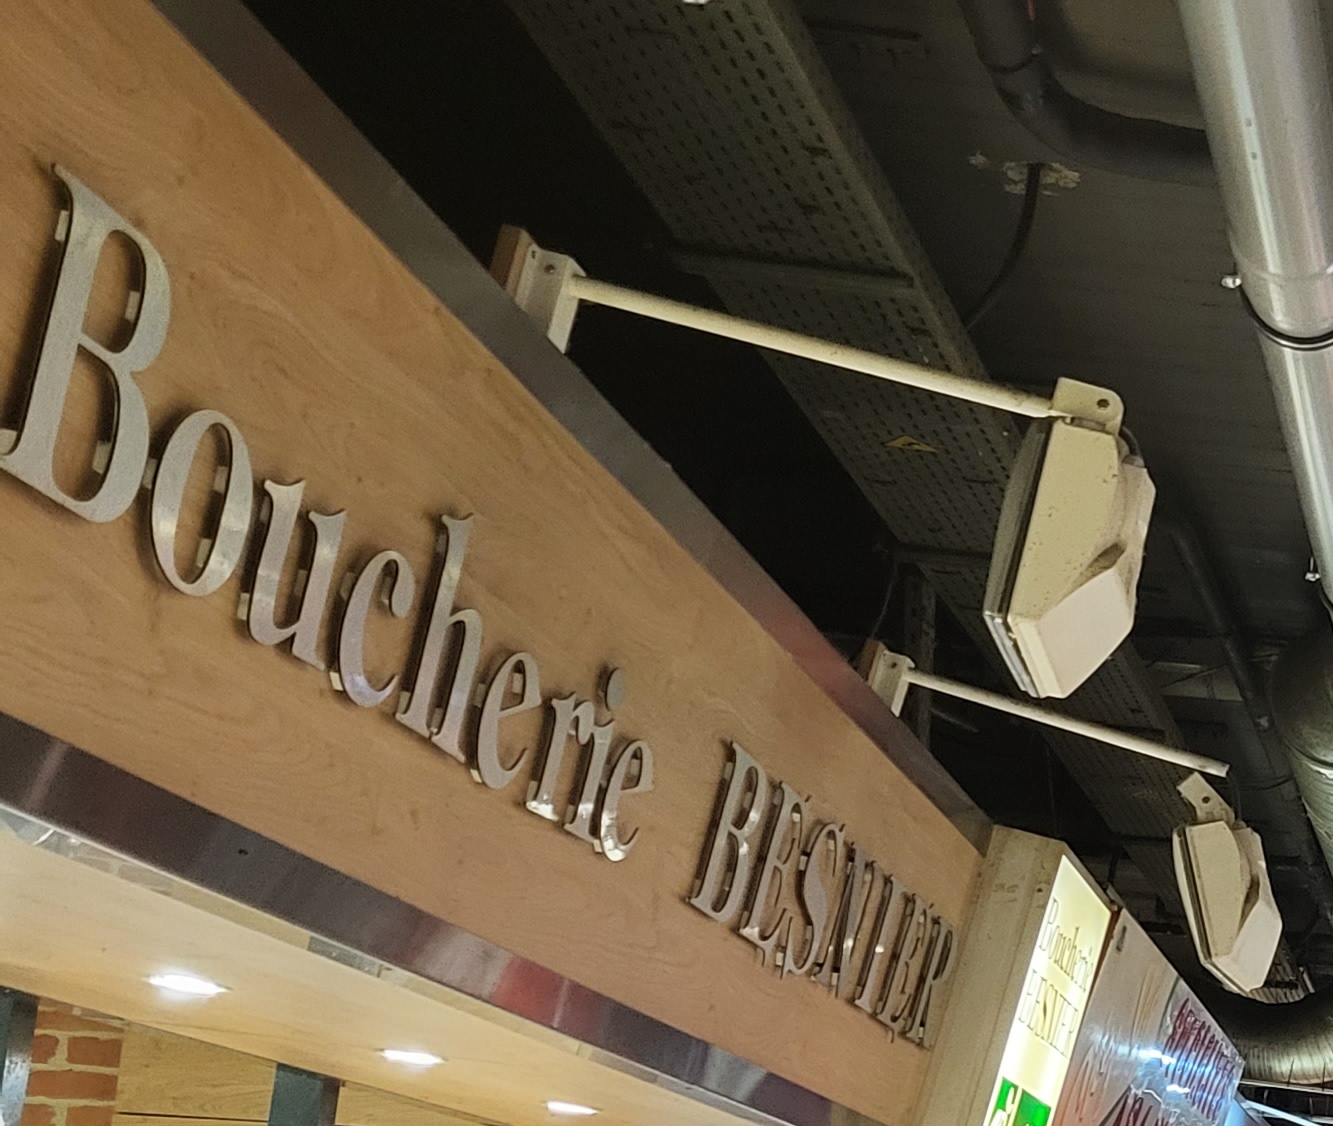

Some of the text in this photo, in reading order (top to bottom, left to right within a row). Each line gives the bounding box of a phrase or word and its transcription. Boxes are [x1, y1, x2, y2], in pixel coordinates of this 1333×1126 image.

[0, 163, 958, 1047] Boucherie BESNIER
[1040, 896, 1094, 993] Boucherie
